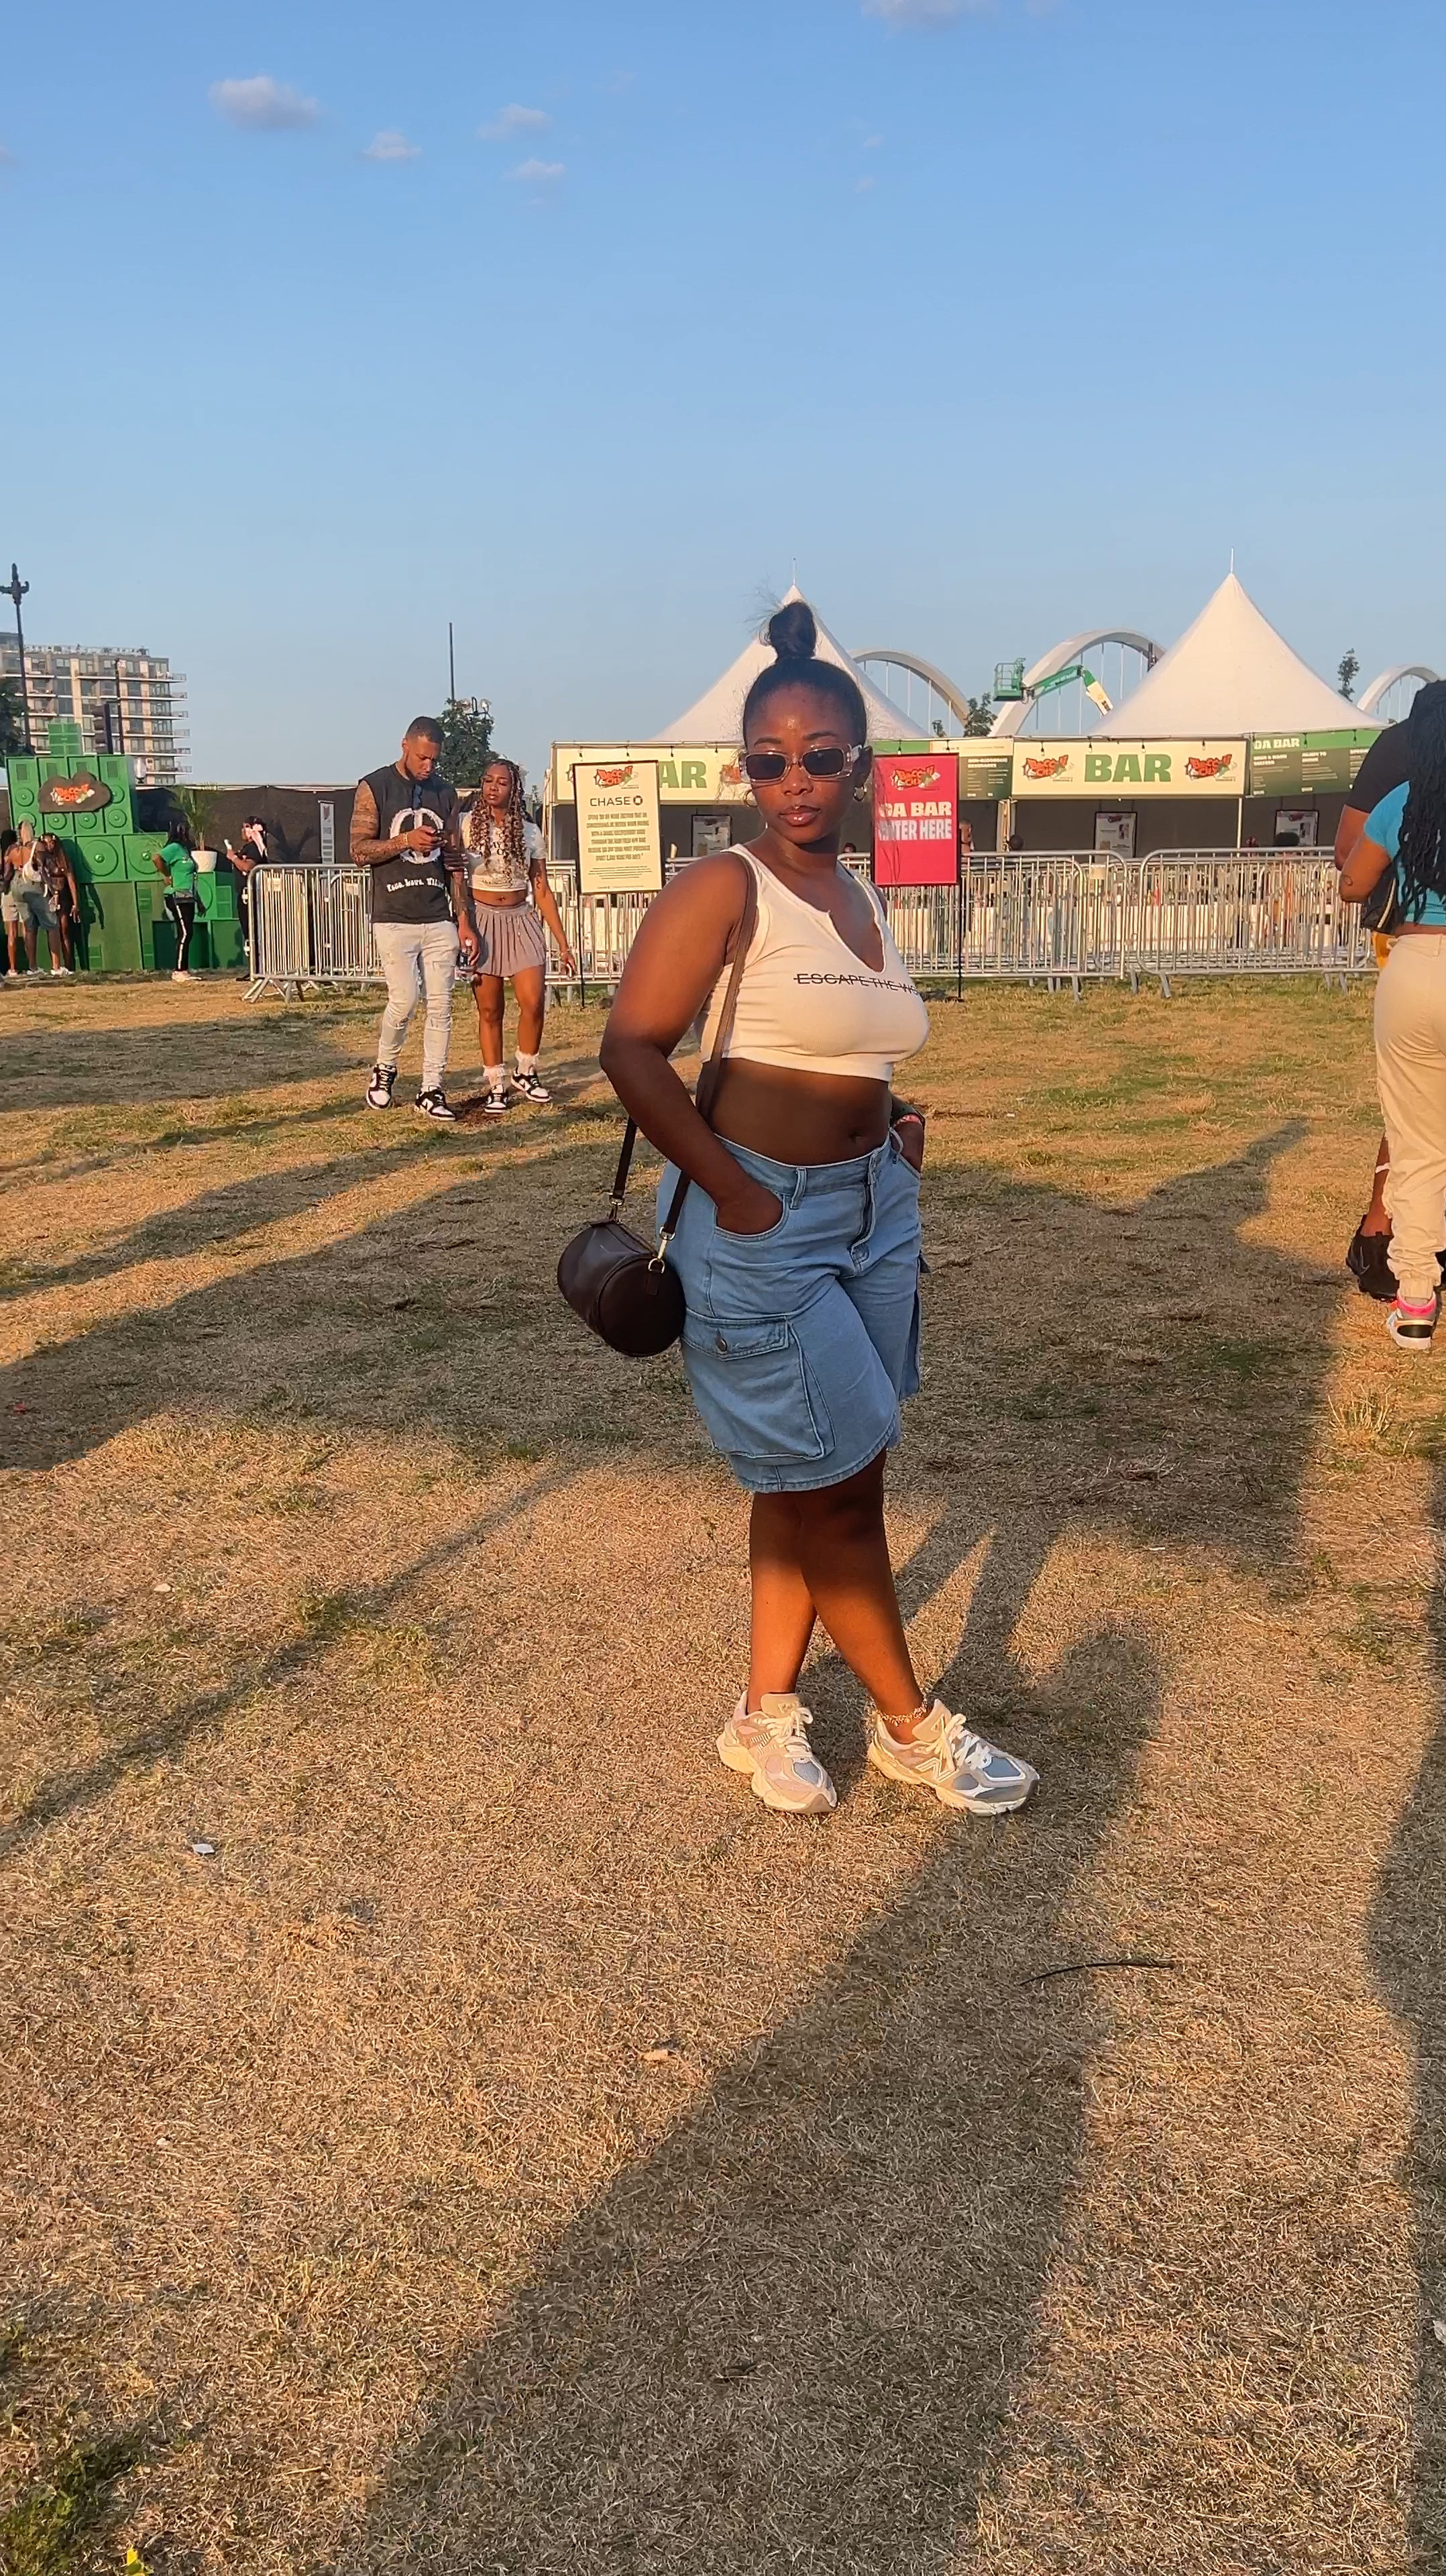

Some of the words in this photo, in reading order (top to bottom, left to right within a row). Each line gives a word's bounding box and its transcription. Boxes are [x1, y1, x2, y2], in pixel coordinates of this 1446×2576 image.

[1274, 738, 1300, 749] BAR
[659, 760, 707, 788] AR
[1084, 754, 1172, 782] BAR
[590, 797, 631, 806] CHASE
[910, 801, 952, 817] BAR
[920, 818, 952, 840] HERE
[797, 973, 869, 987] ESCAPE
[869, 977, 899, 991] THE
[899, 982, 919, 996] WO
